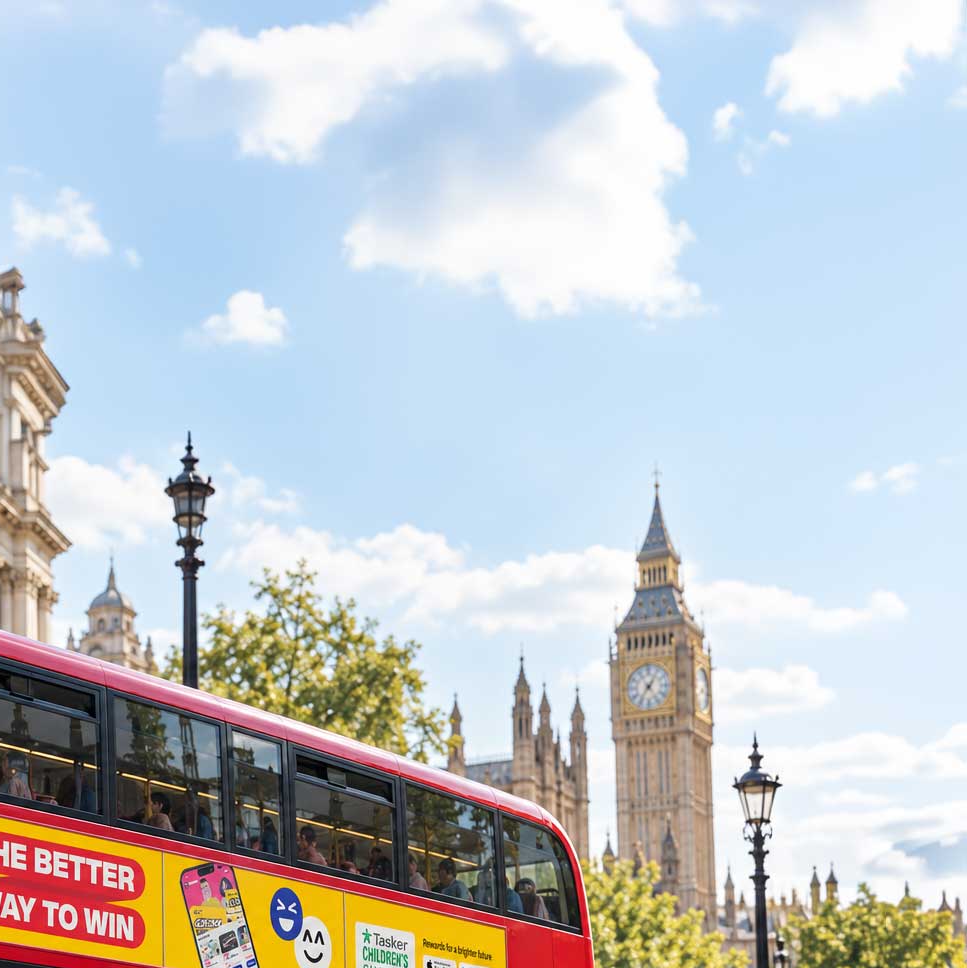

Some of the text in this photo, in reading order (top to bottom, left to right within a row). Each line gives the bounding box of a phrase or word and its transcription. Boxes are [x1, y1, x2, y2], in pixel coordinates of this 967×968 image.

[34, 847, 135, 892] BETTER
[42, 900, 78, 931] TO
[84, 908, 134, 941] WIN
[373, 932, 408, 951] Tasker
[423, 939, 445, 951] Rewards
[362, 945, 409, 968] CHILDREN'S
